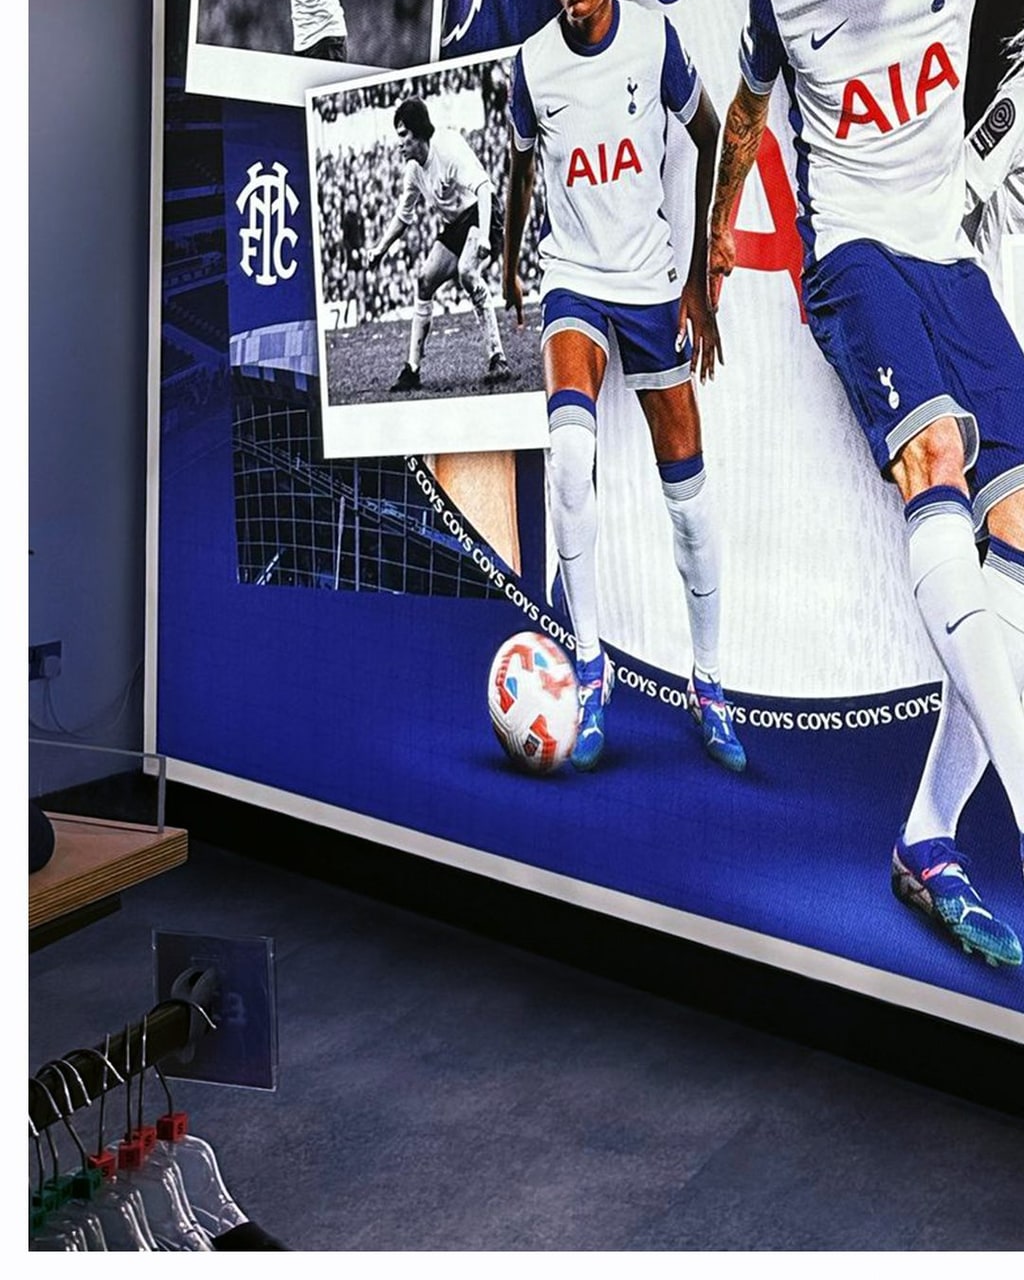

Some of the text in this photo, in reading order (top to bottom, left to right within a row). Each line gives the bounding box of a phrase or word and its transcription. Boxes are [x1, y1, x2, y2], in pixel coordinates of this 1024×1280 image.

[835, 40, 961, 140] AIA
[566, 137, 644, 188] AIA
[415, 470, 446, 513] COYS
[442, 510, 474, 552] COYS
[472, 548, 506, 588] COYS
[504, 583, 541, 621] COYS
[539, 614, 577, 651] COYS
[616, 666, 657, 698] COYS
[659, 685, 688, 710] COY
[750, 708, 794, 730] COYS
[796, 712, 843, 731] COYS
[845, 705, 892, 729] COYS
[894, 692, 942, 721] COYS
